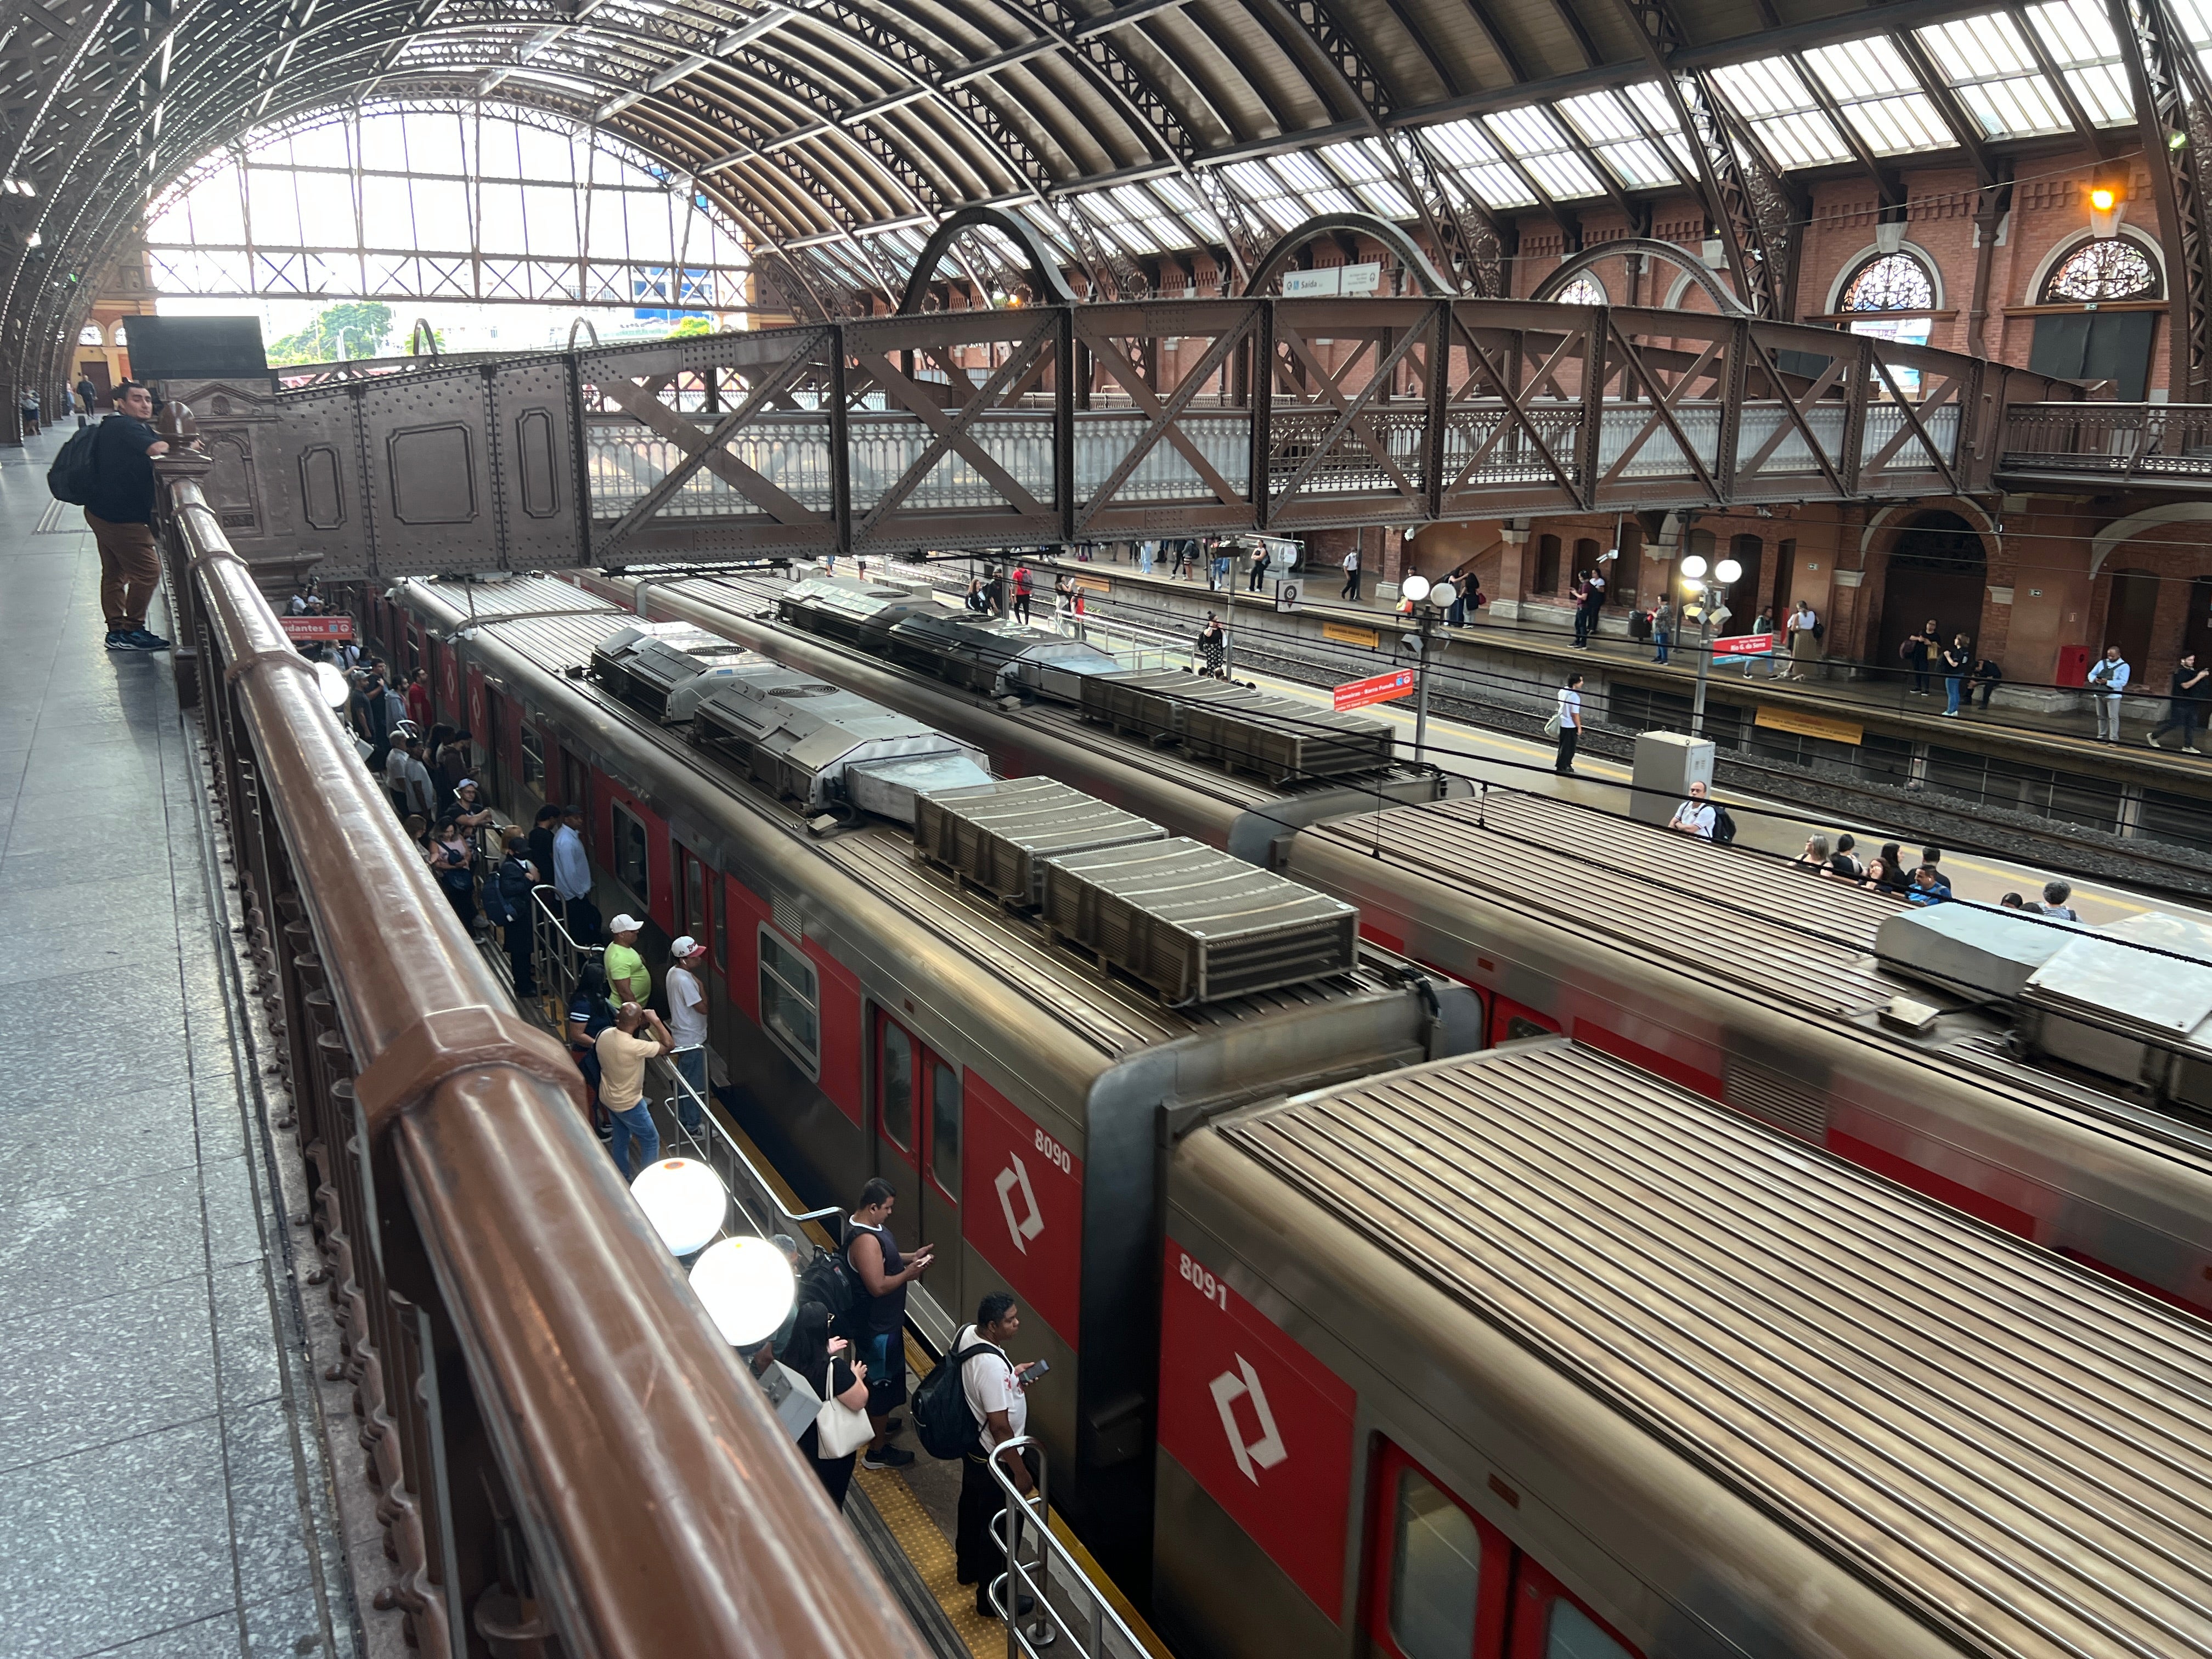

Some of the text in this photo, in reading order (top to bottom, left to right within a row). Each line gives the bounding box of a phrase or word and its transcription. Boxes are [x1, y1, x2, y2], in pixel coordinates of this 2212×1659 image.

[1301, 280, 1317, 289] Saída
[283, 624, 324, 632] udantes
[1335, 692, 1361, 702] Palmeiras
[1378, 682, 1395, 691] Funda
[1035, 1128, 1071, 1174] 8090
[1180, 1252, 1226, 1312] 8091
